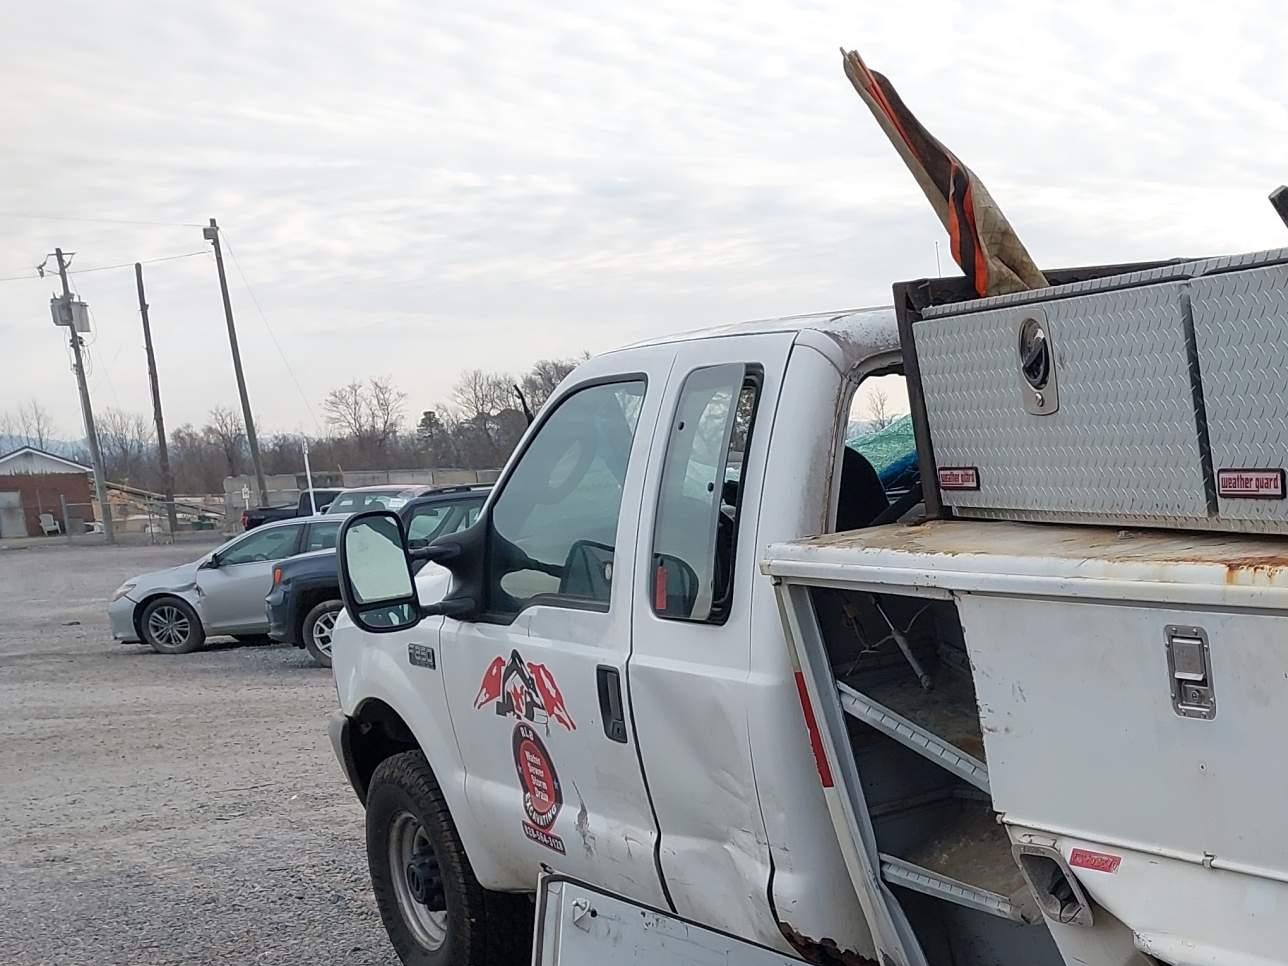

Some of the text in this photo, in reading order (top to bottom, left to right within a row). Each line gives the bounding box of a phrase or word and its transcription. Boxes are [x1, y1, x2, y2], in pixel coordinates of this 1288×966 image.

[1221, 474, 1279, 491] weather guard
[525, 792, 557, 827] EXCAVATING
